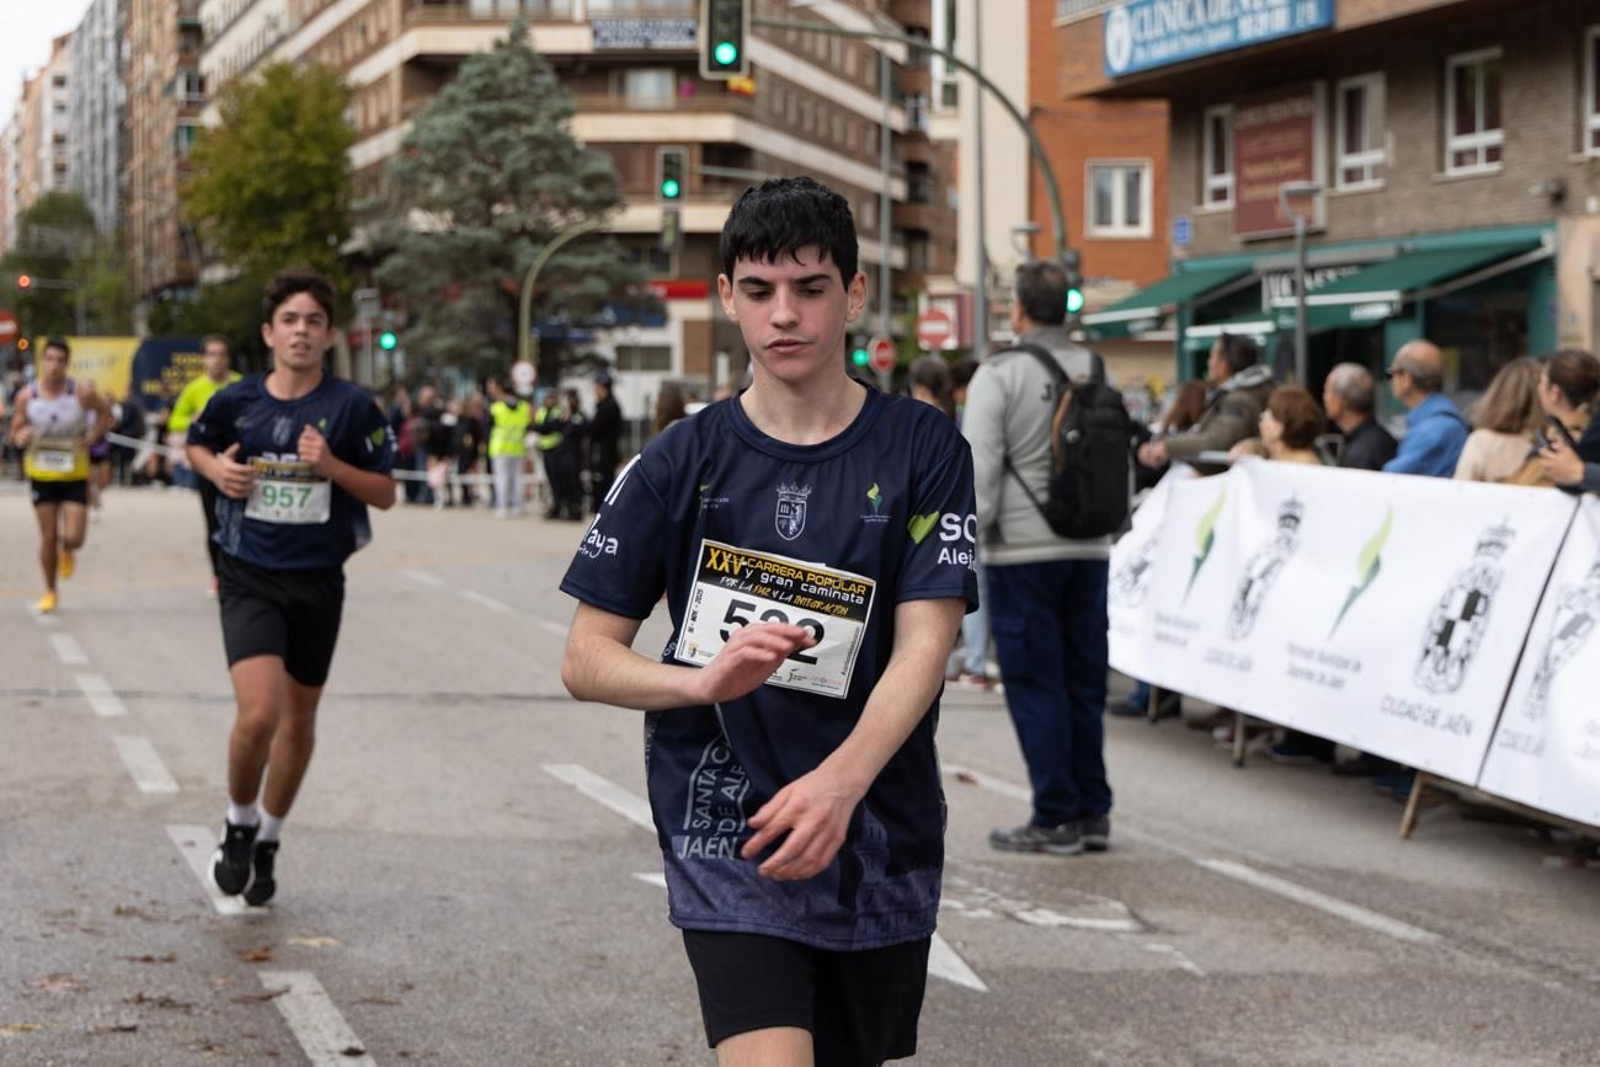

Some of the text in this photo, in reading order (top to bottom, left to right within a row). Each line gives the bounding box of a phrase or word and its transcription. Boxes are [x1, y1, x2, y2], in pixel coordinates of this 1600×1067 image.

[262, 484, 313, 509] 957
[705, 547, 746, 576] XXV
[937, 547, 977, 571] Alej
[746, 567, 865, 605] y gran caminata
[747, 558, 867, 595] CARRERA POPULAR
[738, 580, 753, 593] LA
[779, 591, 794, 603] LA
[692, 767, 722, 829] SANTA
[717, 806, 737, 832] DE
[677, 832, 738, 860] JAÉN
